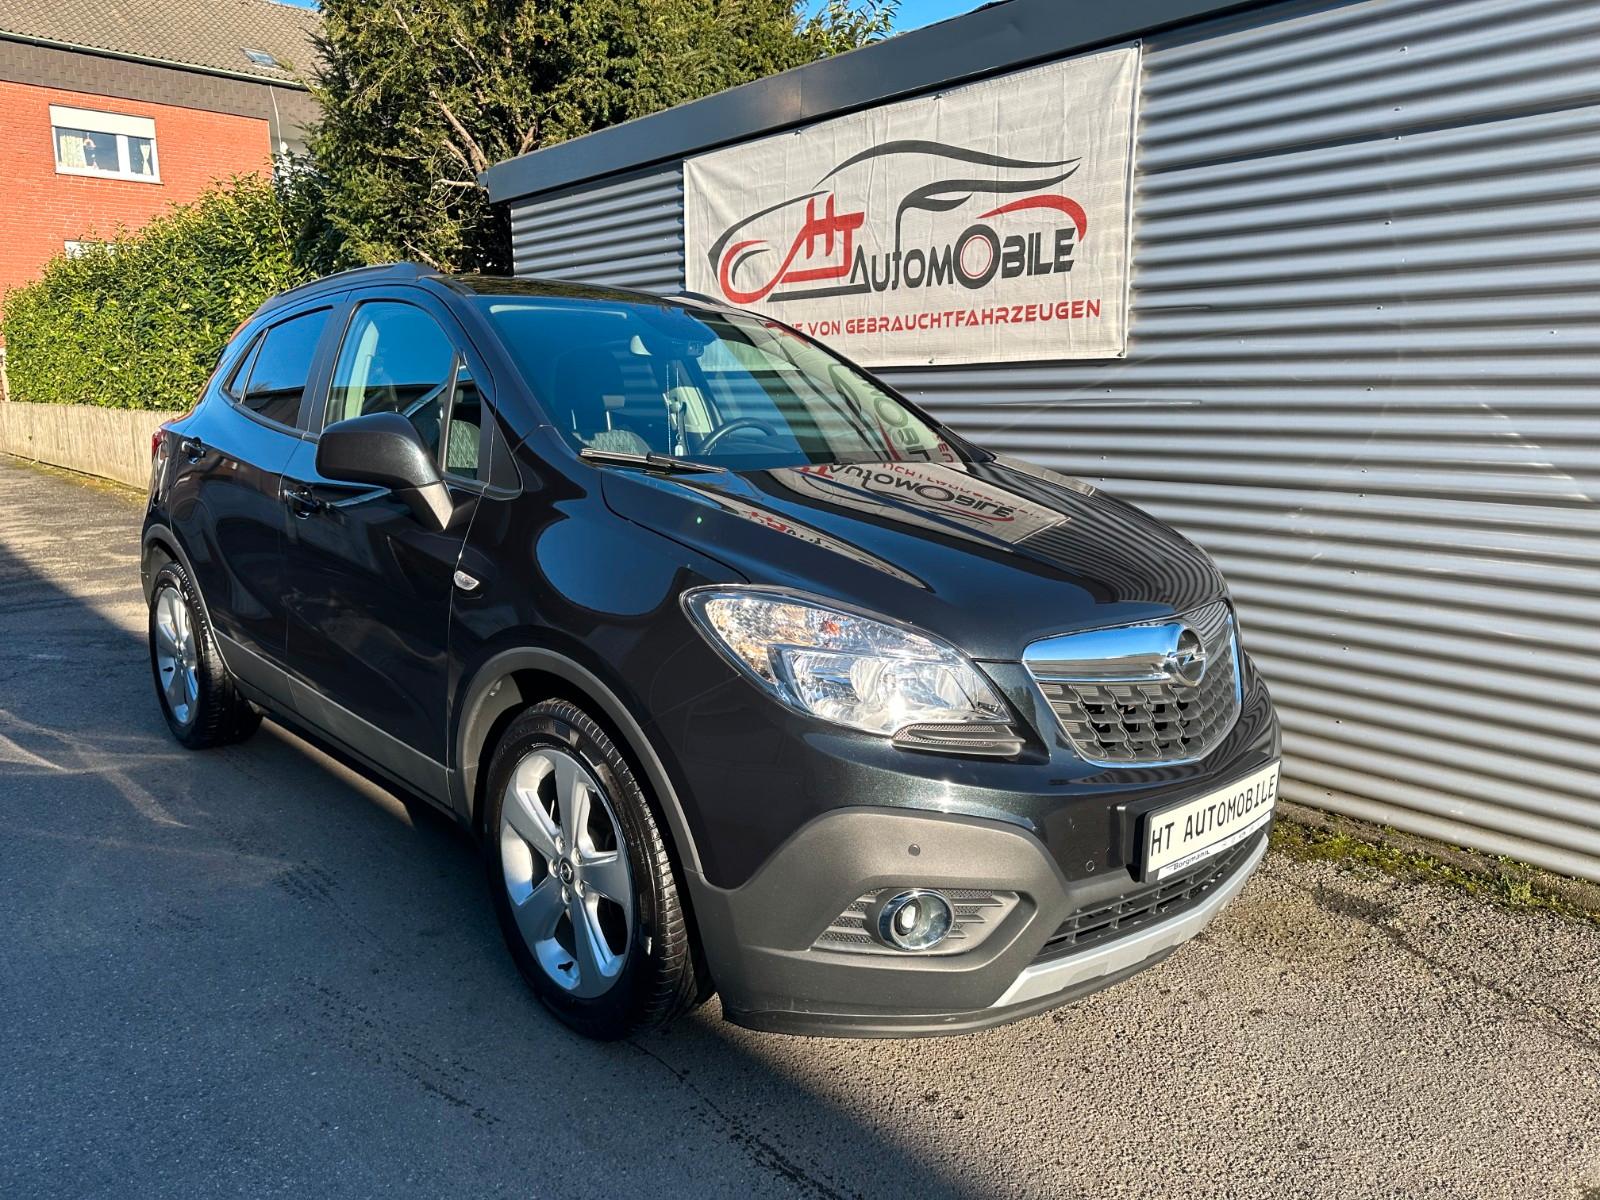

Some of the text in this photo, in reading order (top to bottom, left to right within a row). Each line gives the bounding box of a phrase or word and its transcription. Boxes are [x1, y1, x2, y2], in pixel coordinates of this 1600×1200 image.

[850, 223, 1076, 293] AUTOMOBILE
[807, 320, 841, 337] VON
[845, 298, 1101, 335] GEBRAUCHTFAHRZEUGEN
[1150, 822, 1175, 857] HT
[1183, 774, 1276, 843] AUTOMOBILE
